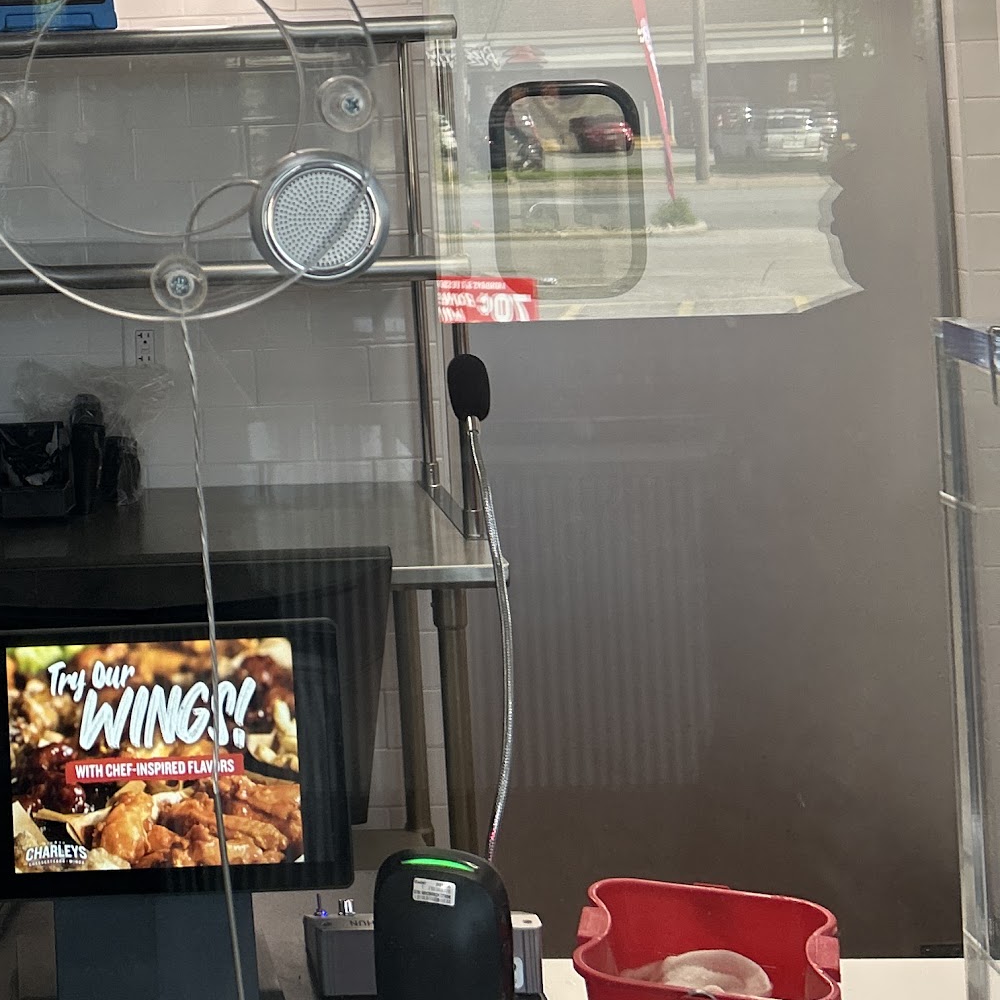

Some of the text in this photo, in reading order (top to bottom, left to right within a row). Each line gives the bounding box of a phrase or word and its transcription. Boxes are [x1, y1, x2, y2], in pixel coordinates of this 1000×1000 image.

[48, 660, 135, 702] Try Our
[79, 677, 256, 751] WINGS!
[75, 764, 103, 779] WITH
[105, 760, 186, 777] CHEF-INSPIRED
[25, 844, 88, 861] CHARLEYS
